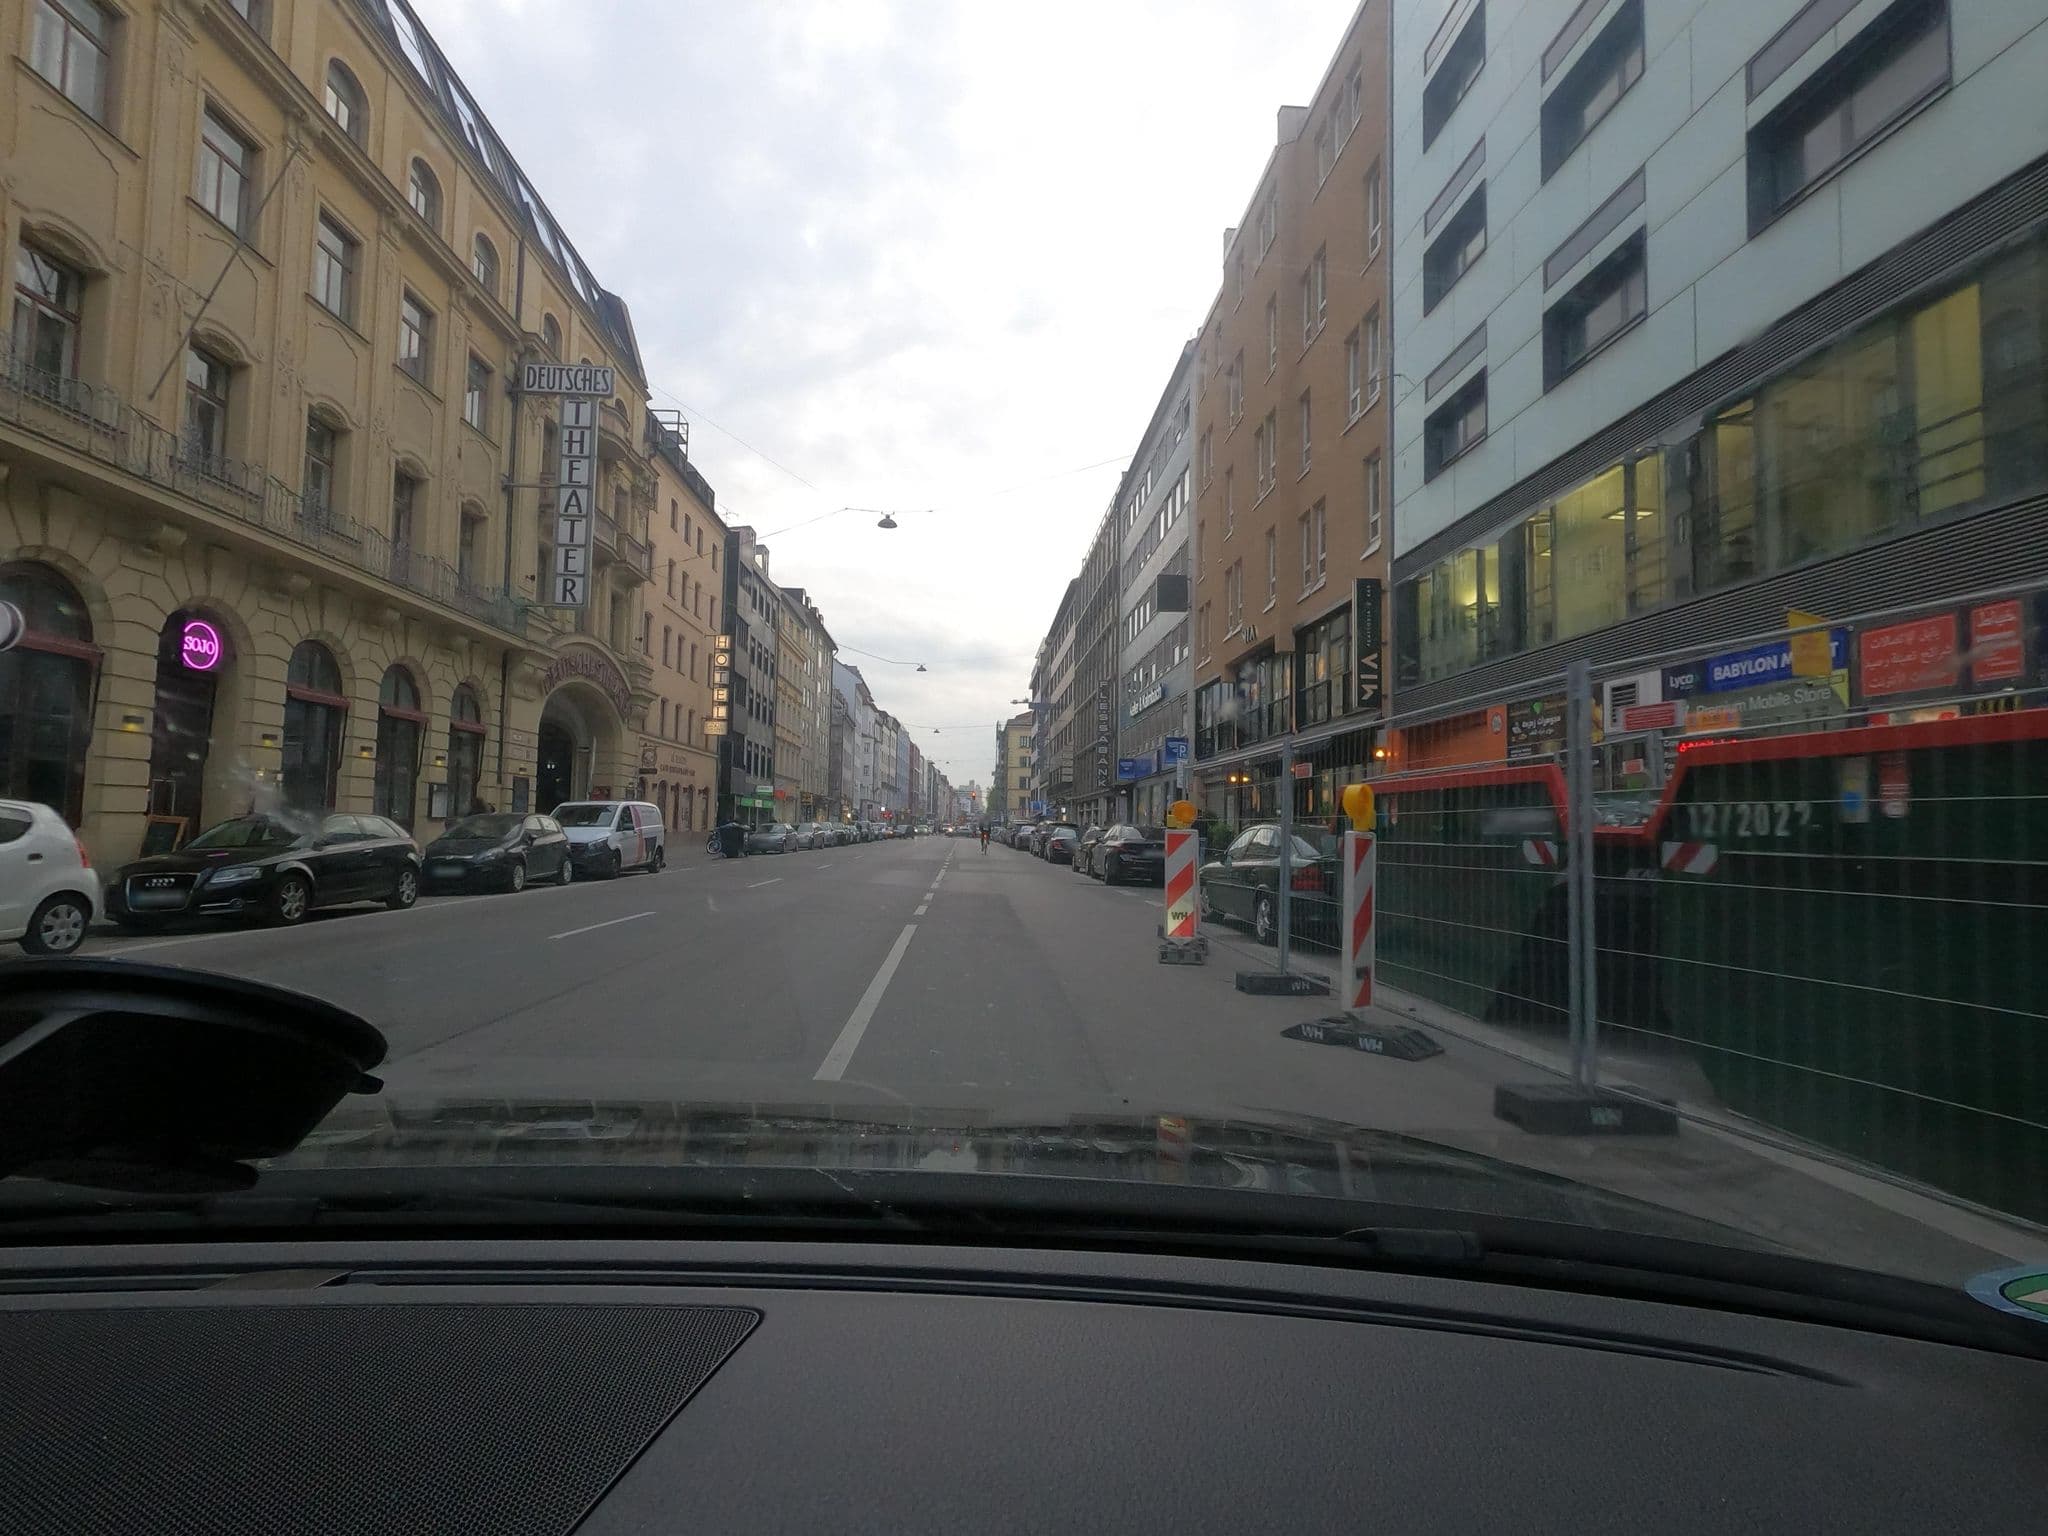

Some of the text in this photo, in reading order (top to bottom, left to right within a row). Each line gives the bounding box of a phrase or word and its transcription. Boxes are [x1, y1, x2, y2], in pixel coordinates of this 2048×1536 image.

[526, 366, 611, 392] DEUTSCHES
[561, 400, 588, 602] THEATER
[184, 636, 215, 654] SOJO
[716, 636, 728, 718] HOTEL
[1360, 652, 1378, 700] MIA
[1713, 656, 1779, 681] BABYLON
[1669, 674, 1694, 689] Lyco
[1750, 693, 1790, 711] Mobile
[1794, 686, 1831, 704] Store
[1181, 744, 1187, 757] P
[1171, 911, 1189, 920] WH
[1301, 1024, 1324, 1040] WH
[1358, 1036, 1383, 1053] WH
